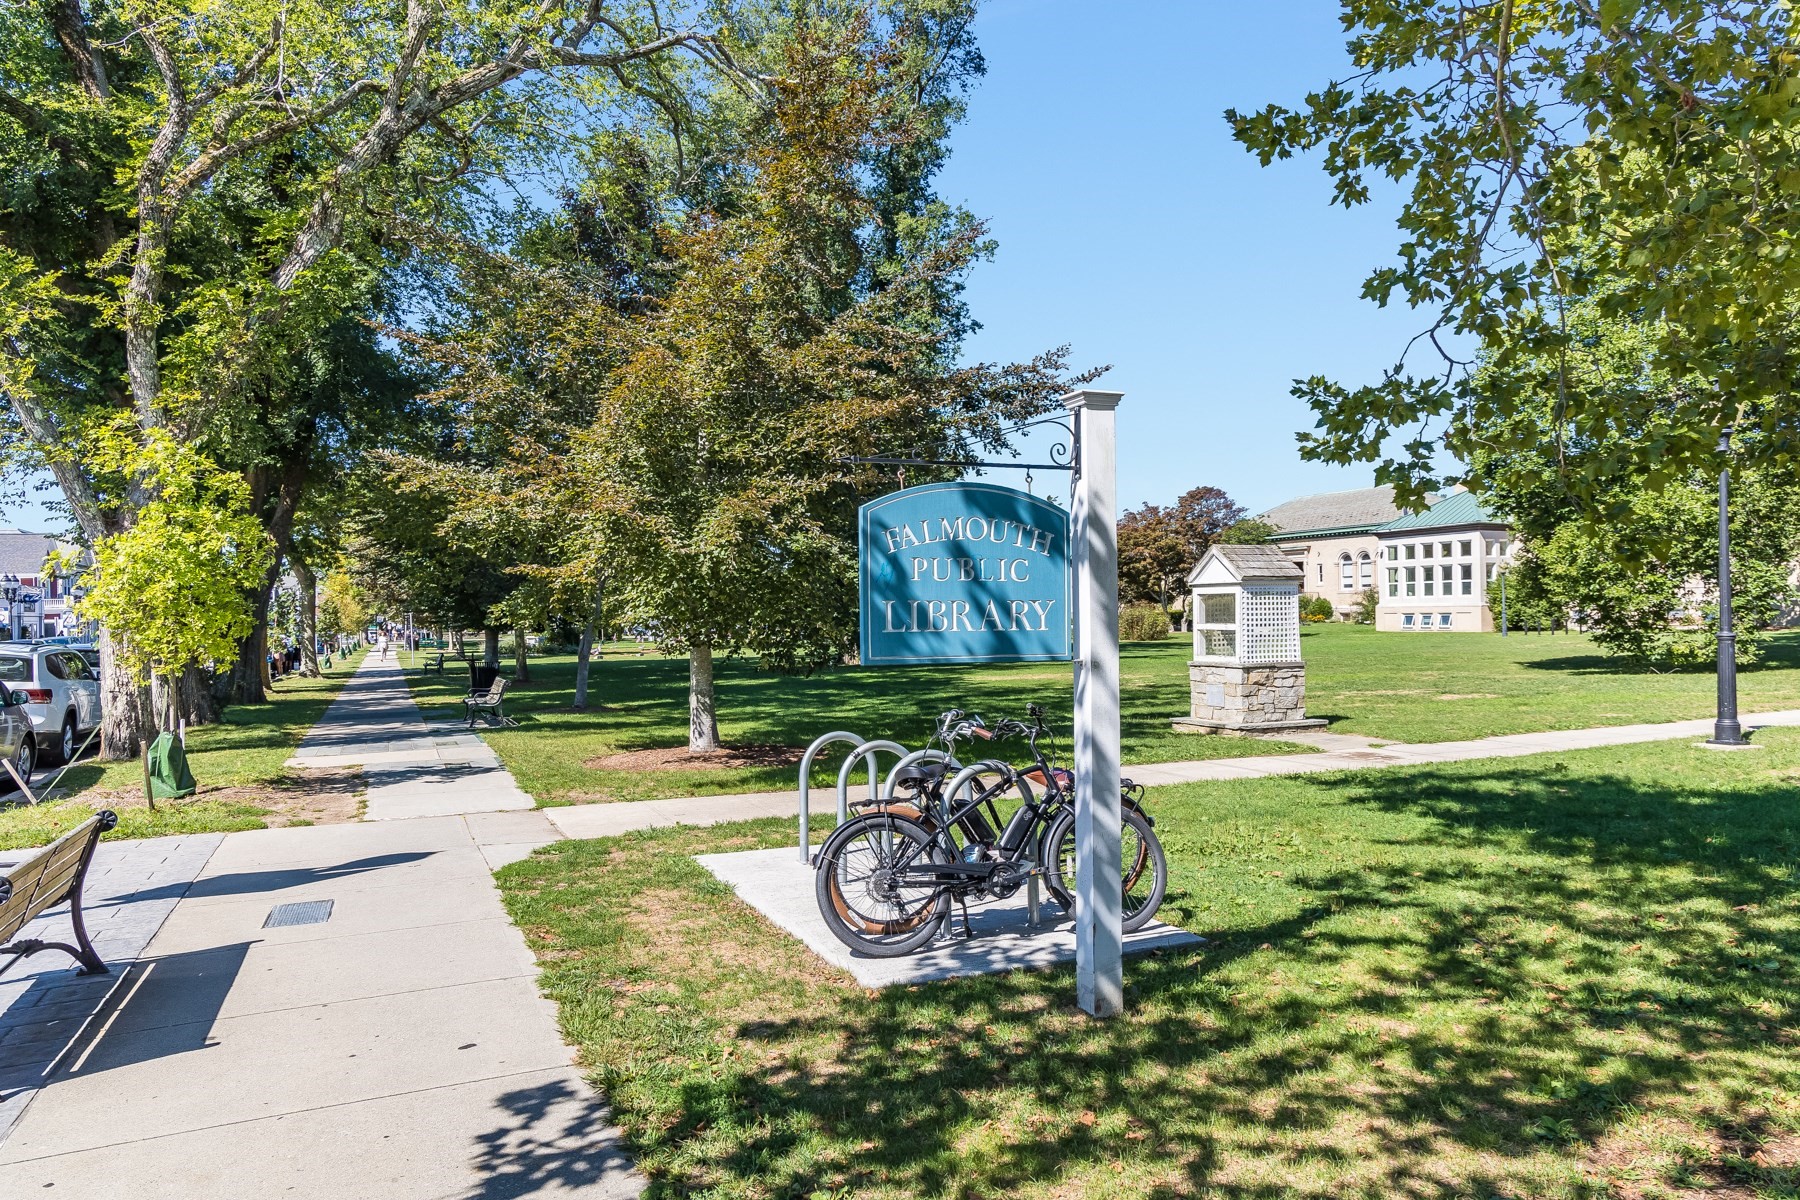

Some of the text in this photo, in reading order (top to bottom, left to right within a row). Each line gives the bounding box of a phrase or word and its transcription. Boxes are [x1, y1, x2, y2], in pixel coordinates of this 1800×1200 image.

[881, 516, 1055, 557] FALMOUTH
[910, 557, 1030, 583] PUBLIC
[881, 598, 1056, 633] LIBRARY
